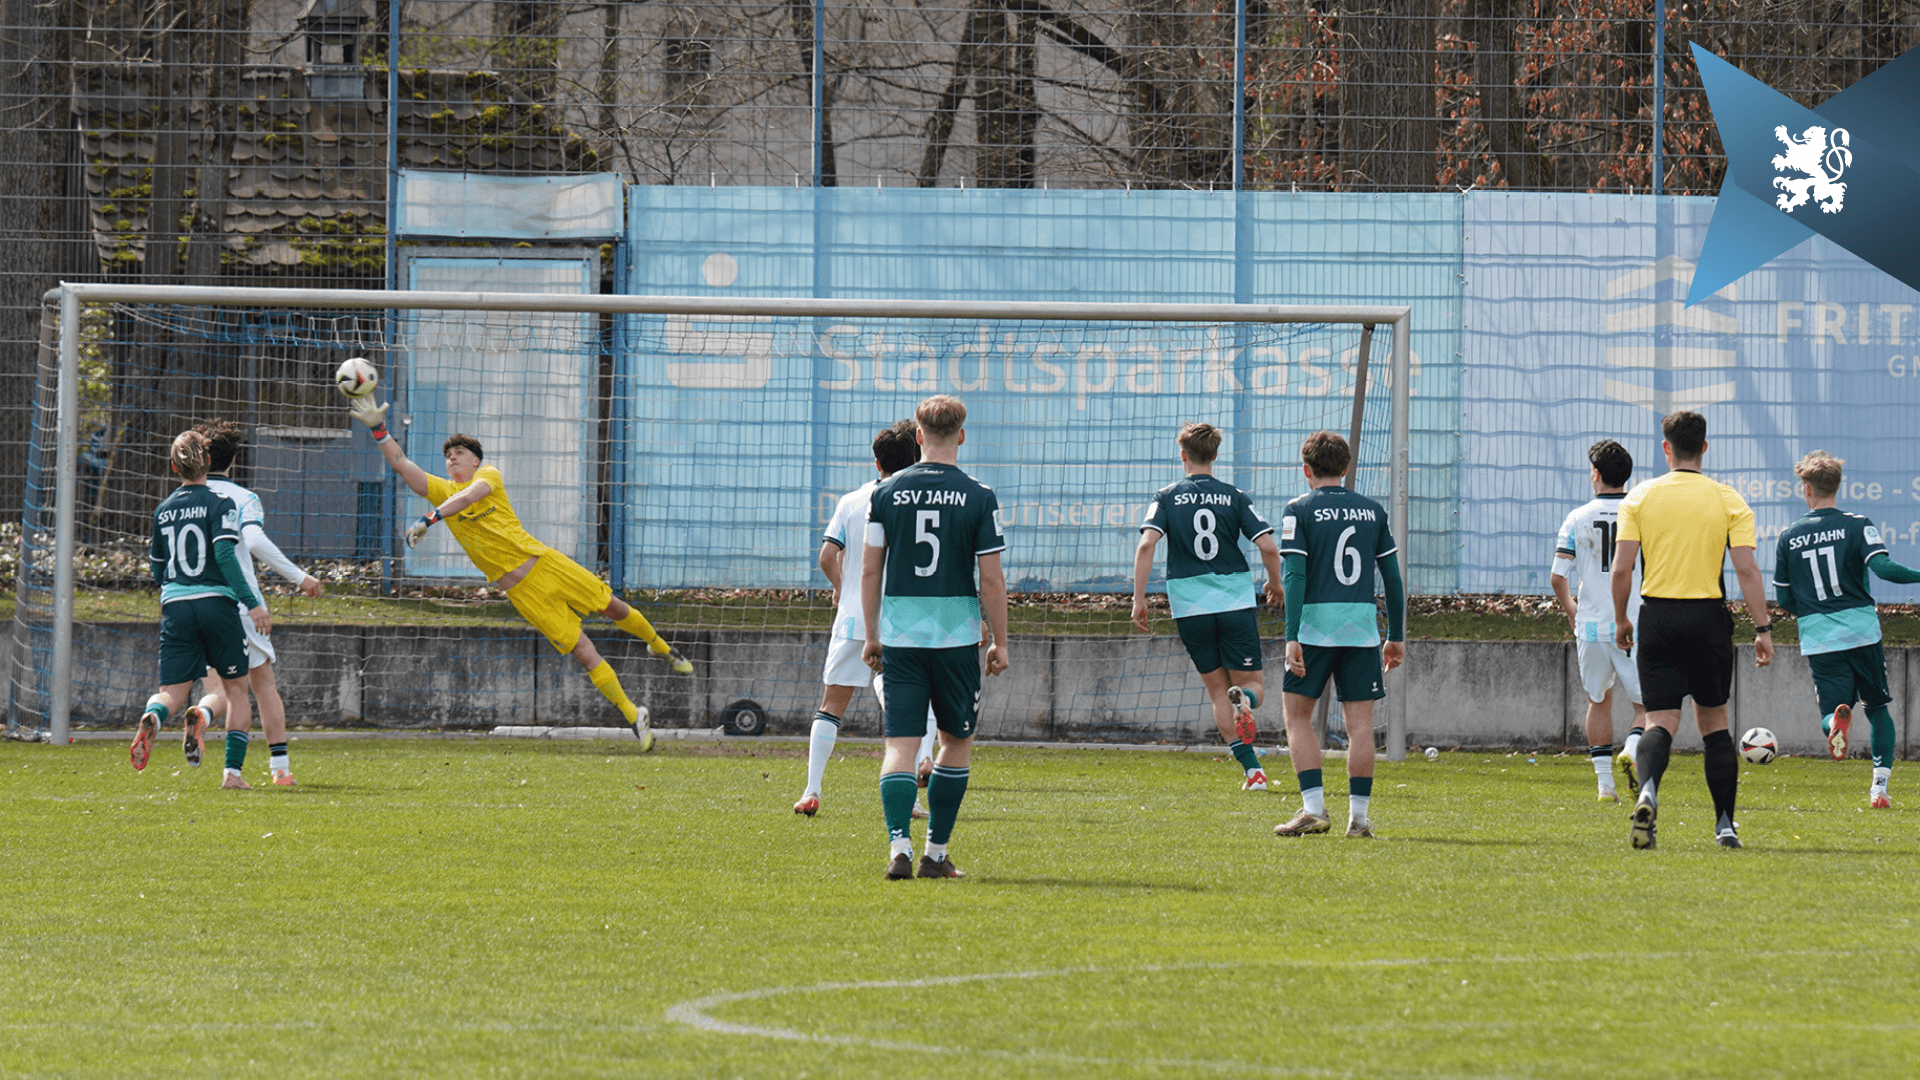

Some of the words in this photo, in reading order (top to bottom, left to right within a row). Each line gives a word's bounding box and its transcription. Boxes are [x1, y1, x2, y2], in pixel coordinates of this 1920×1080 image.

[1777, 302, 1920, 346] FRIT
[818, 324, 1422, 411] Stadtsparkasse
[158, 510, 177, 525] SSV
[179, 506, 208, 520] JAHN
[893, 490, 922, 506] SSV
[925, 490, 967, 507] JAHN
[999, 502, 1145, 527] unserer
[1174, 493, 1198, 506] SSV
[1200, 493, 1232, 506] JAHN
[1314, 508, 1339, 522] SSV
[1342, 508, 1376, 522] JAHN
[161, 523, 207, 579] 10
[914, 510, 940, 577] 5
[1193, 508, 1219, 561] 8
[1333, 525, 1362, 586] 6
[1789, 534, 1811, 550] SSV
[1813, 528, 1846, 545] JAHN
[1801, 545, 1843, 601] 11
